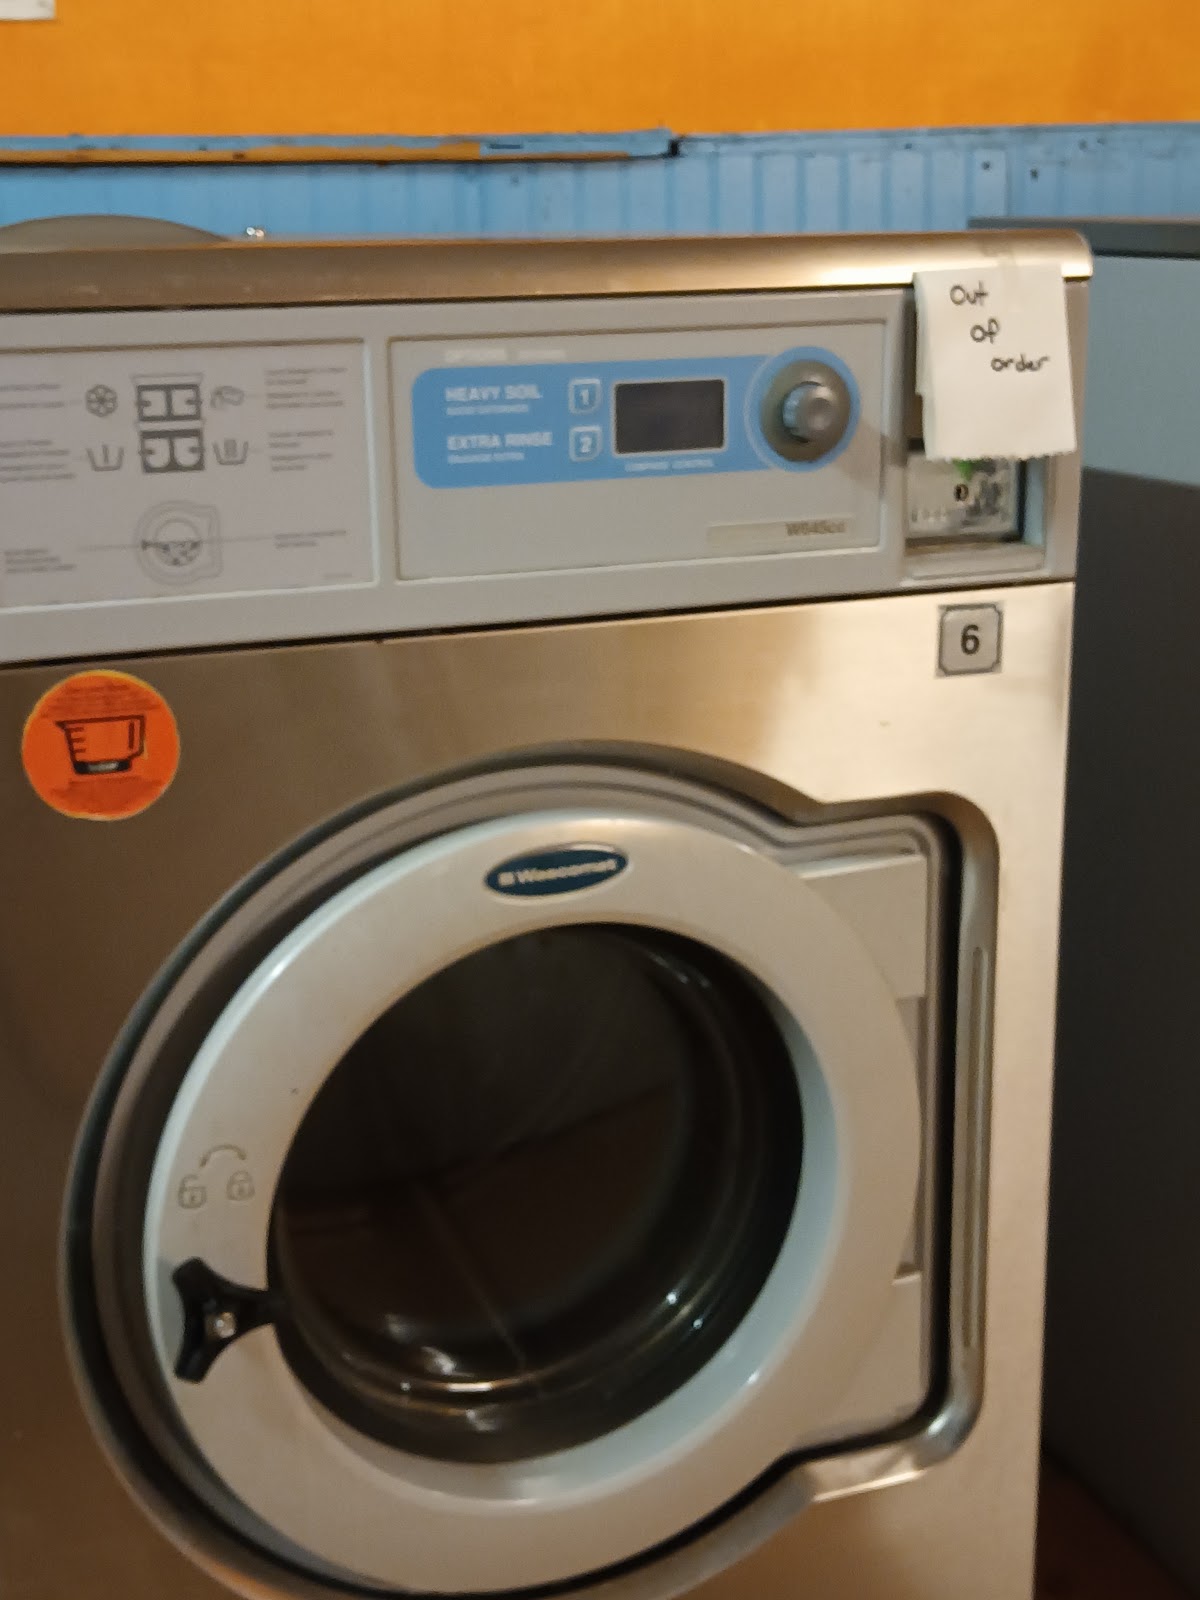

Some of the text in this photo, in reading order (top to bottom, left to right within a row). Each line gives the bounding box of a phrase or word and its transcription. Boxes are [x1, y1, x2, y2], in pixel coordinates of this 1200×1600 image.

[950, 280, 989, 306] Out
[970, 318, 1000, 343] of
[990, 354, 1050, 372] order
[445, 385, 501, 402] HEAVY
[579, 388, 590, 406] 1
[447, 434, 502, 451] EXTRA
[580, 435, 593, 454] 2
[960, 624, 980, 655] 6
